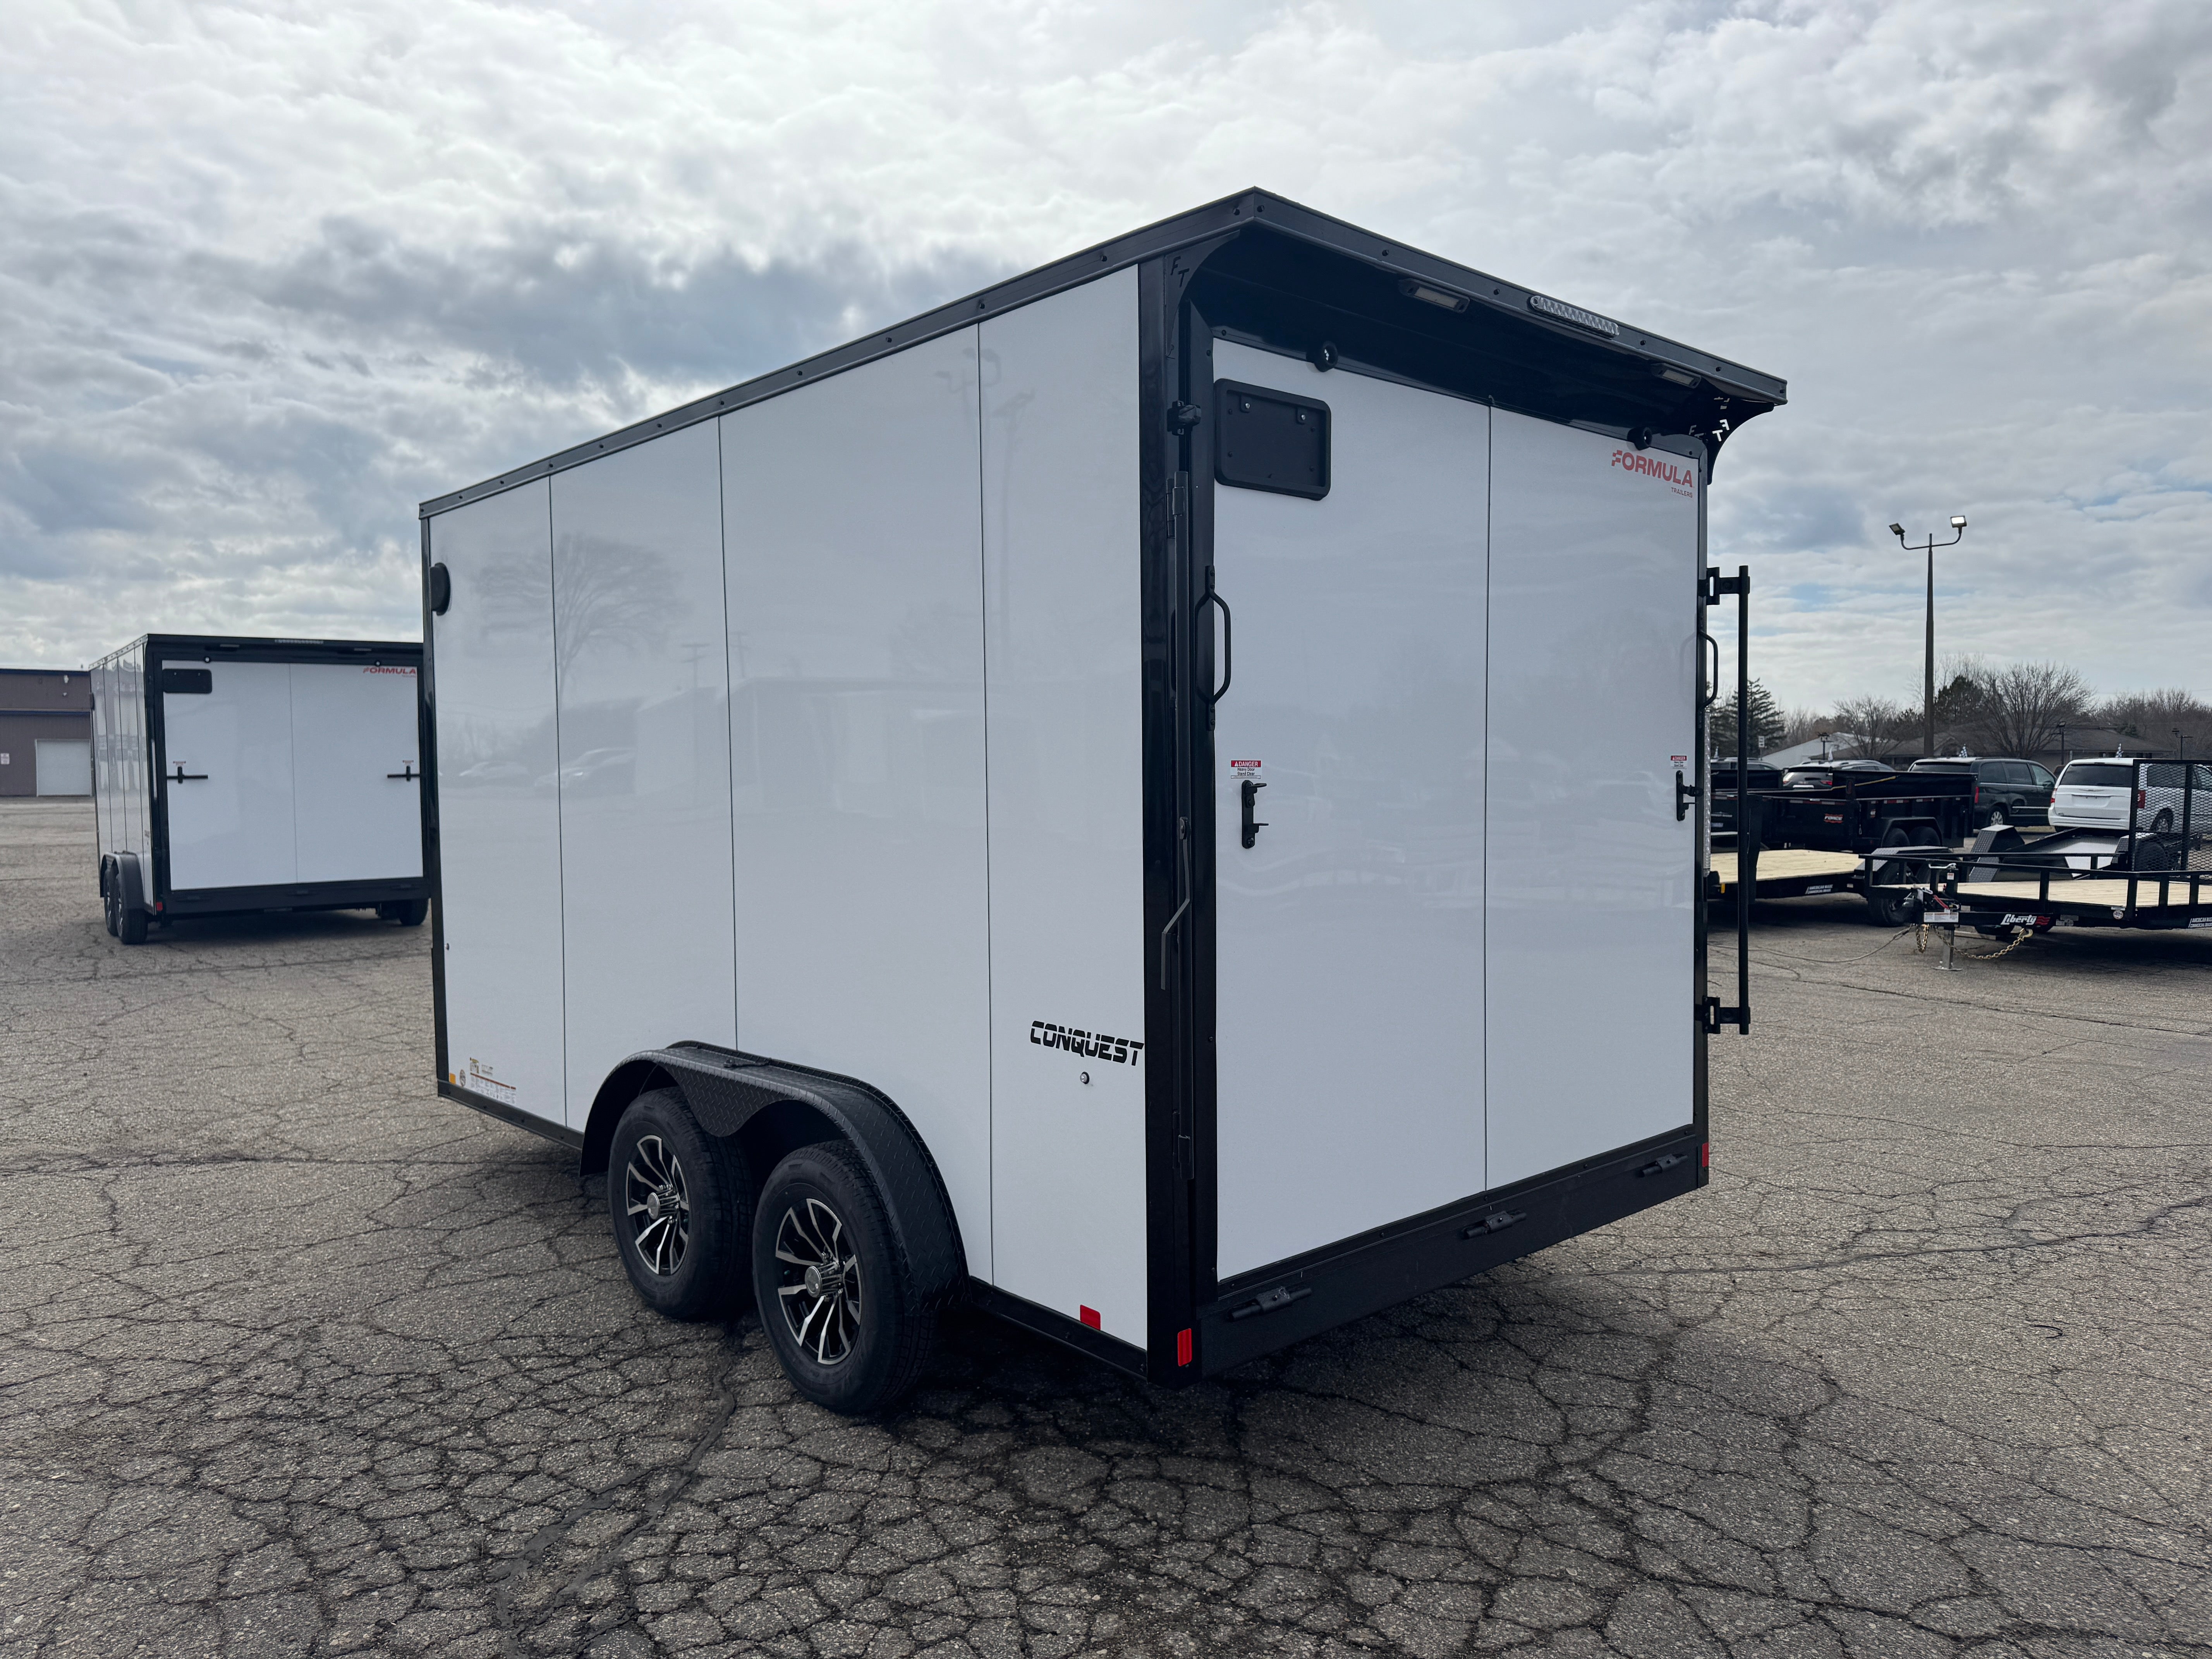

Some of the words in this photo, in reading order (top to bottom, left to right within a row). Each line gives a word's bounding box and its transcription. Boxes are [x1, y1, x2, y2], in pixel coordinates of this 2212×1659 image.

[1611, 449, 1693, 488] FORMULA
[1671, 487, 1693, 498] TRAILERS
[2000, 914, 2037, 926] Liberty
[1030, 1020, 1144, 1066] CONQUEST
